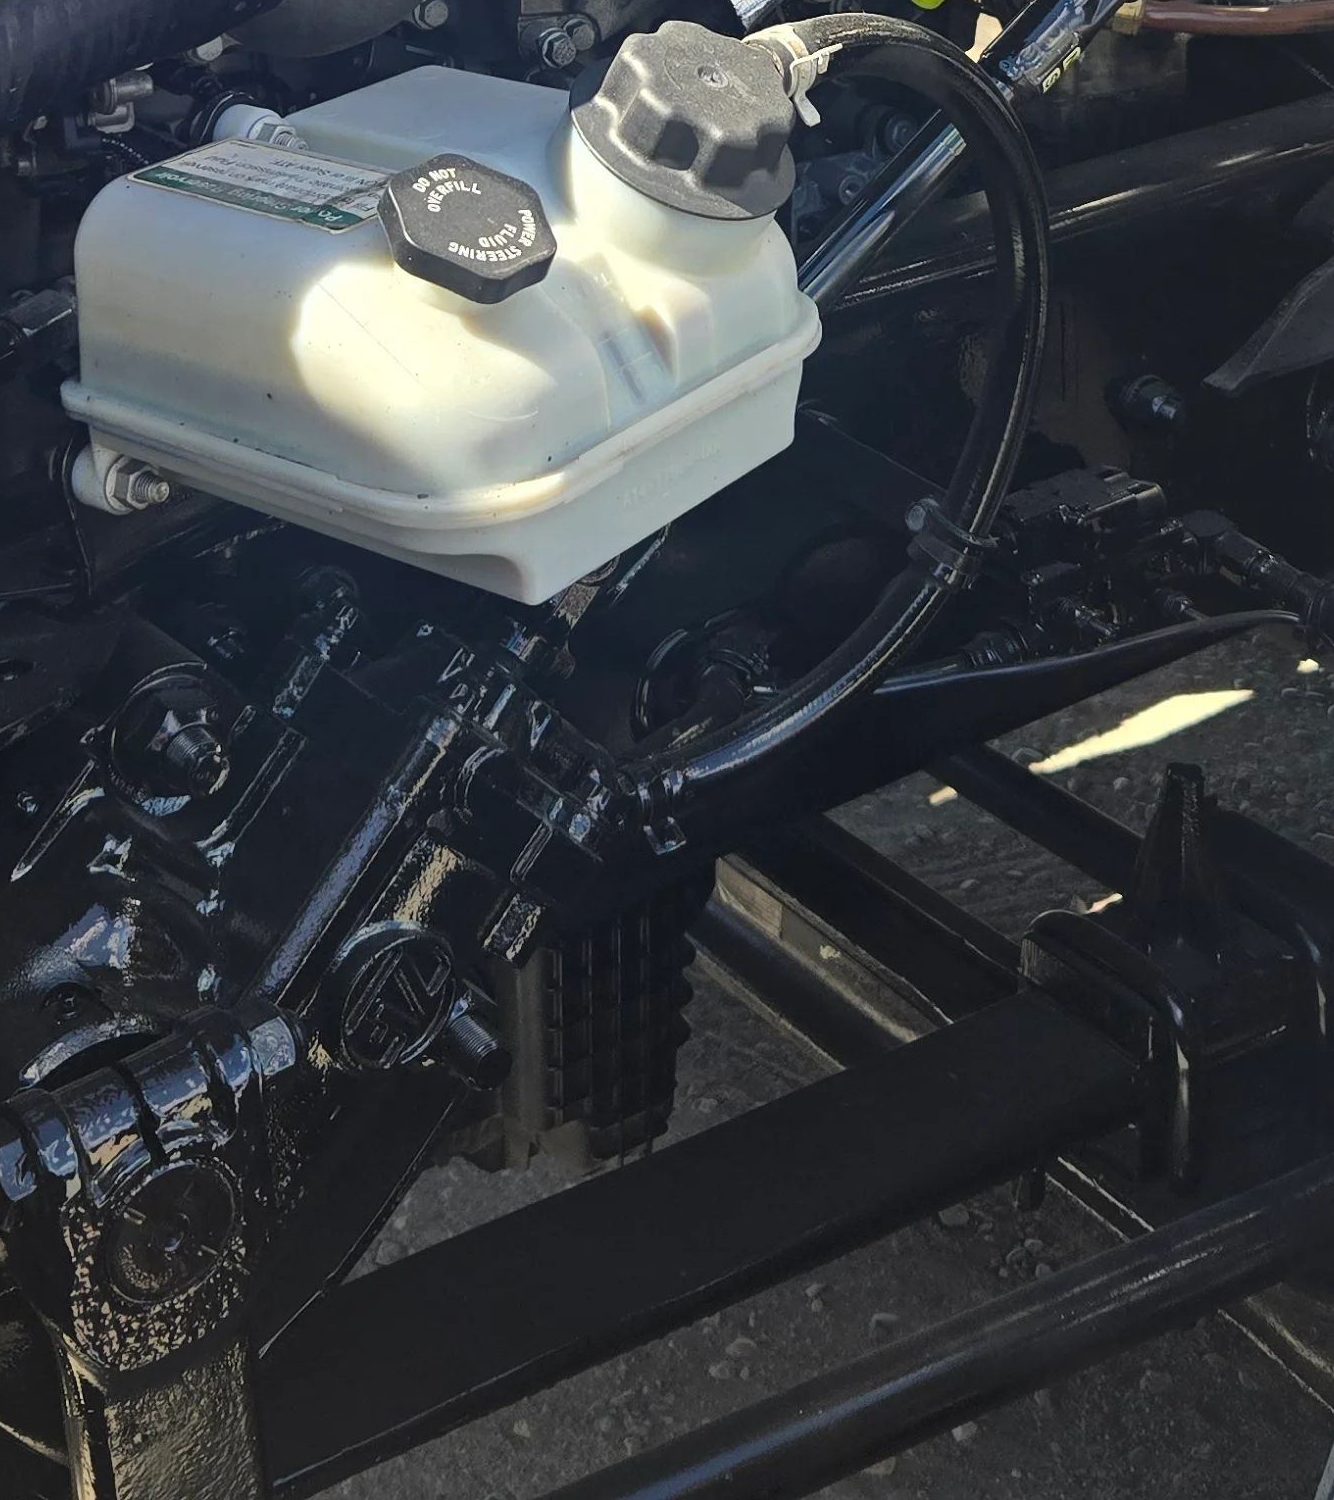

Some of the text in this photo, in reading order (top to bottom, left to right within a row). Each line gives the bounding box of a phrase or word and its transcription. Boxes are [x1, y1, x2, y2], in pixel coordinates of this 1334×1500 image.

[412, 167, 457, 194] DO NOT
[427, 180, 482, 213] OVERFILL
[448, 209, 537, 262] POWER STEERING
[478, 223, 517, 248] FLUID
